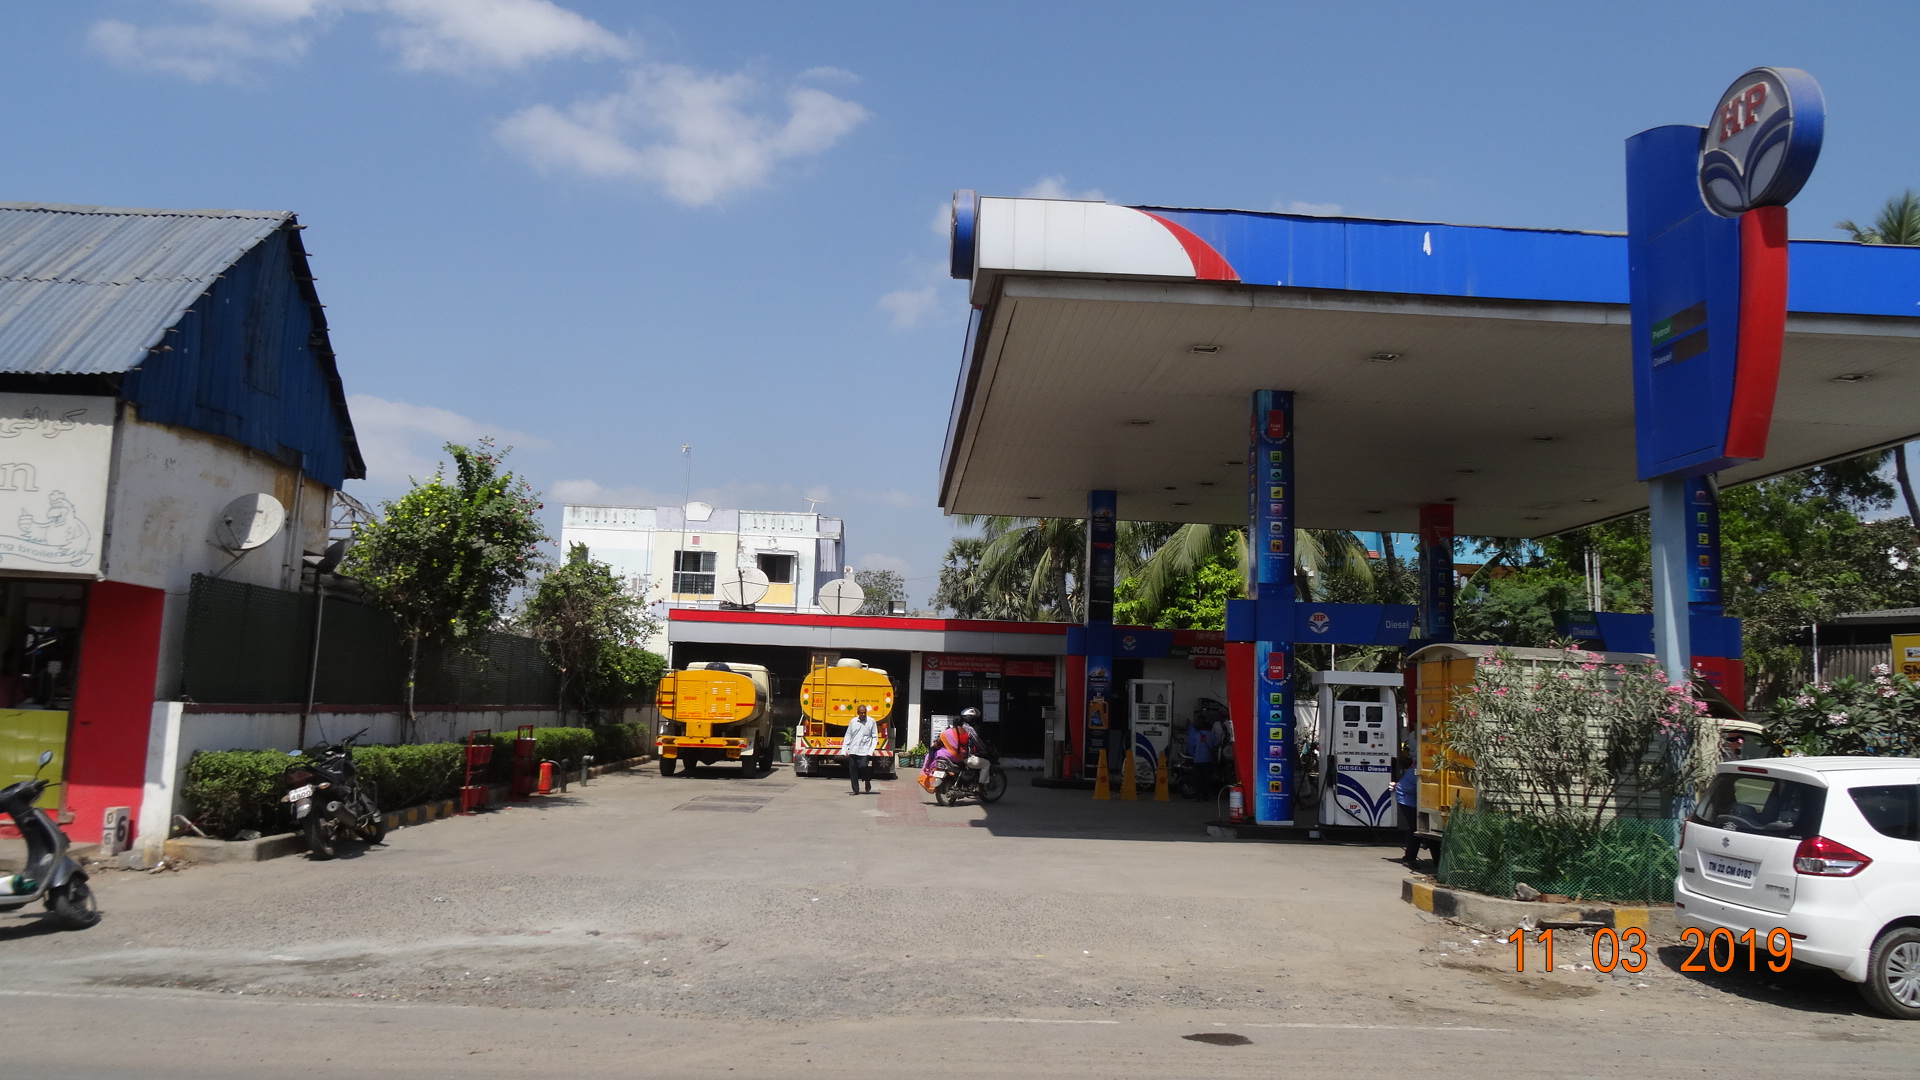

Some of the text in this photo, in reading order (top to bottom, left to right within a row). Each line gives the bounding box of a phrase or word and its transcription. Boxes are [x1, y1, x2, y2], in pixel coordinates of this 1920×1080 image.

[1719, 82, 1767, 142] HP
[1652, 325, 1670, 340] Petrol
[1653, 352, 1672, 366] Diesel
[1385, 620, 1410, 629] Diesel
[1568, 613, 1591, 622] Petrol
[1573, 627, 1596, 637] Diesel
[1198, 659, 1218, 667] ATM
[116, 815, 128, 843] 6
[1709, 861, 1752, 879] TN 22 CM 0183
